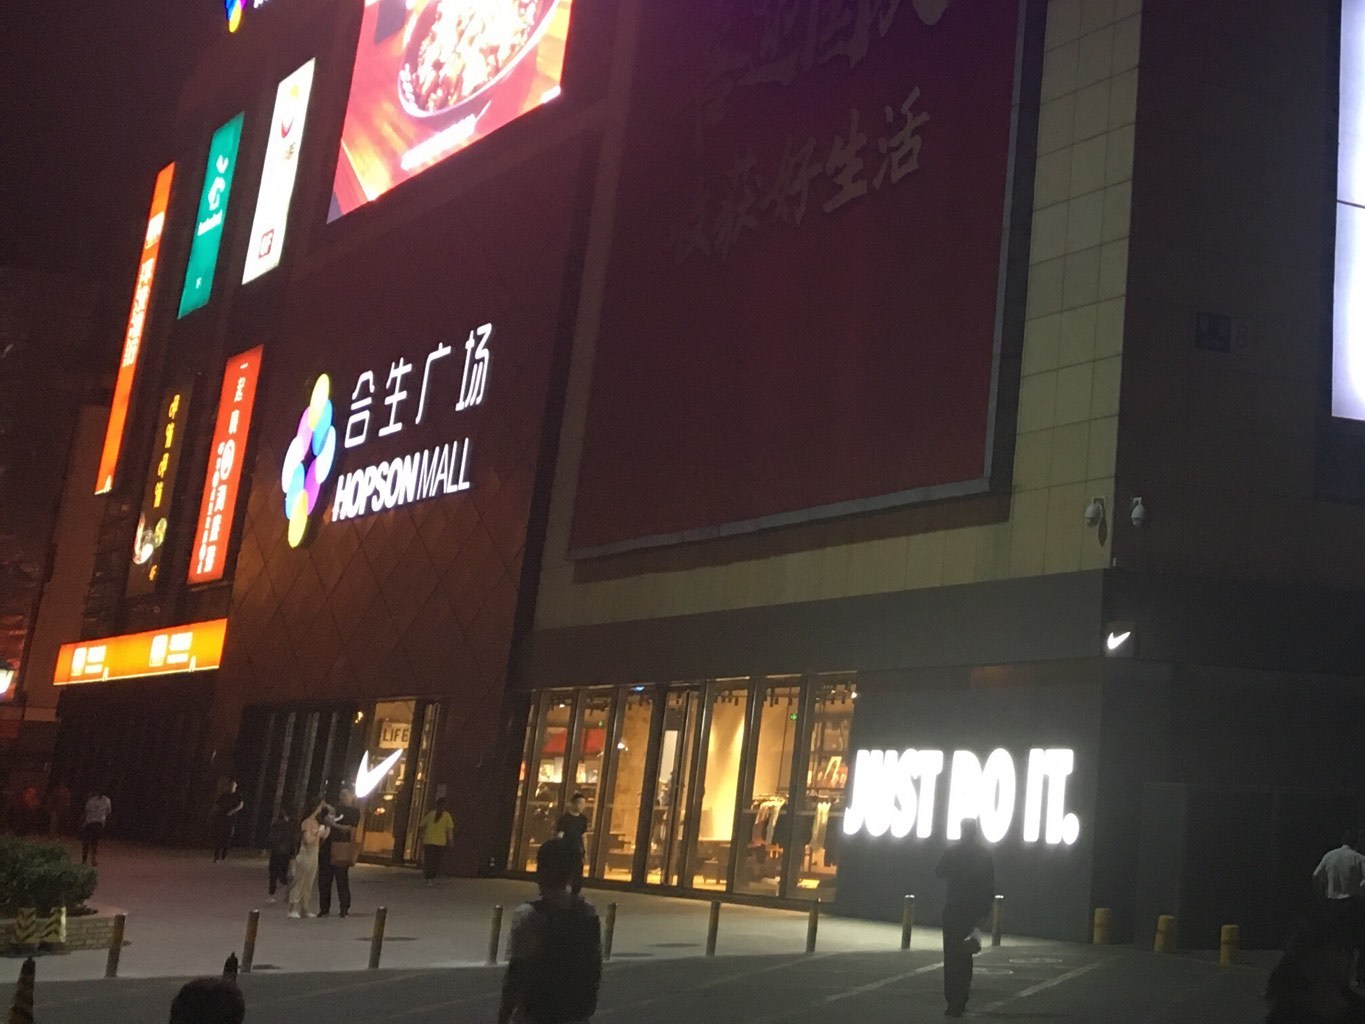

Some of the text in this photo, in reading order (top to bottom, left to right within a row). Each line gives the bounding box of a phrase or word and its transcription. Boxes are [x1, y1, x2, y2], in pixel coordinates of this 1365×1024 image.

[344, 323, 492, 449] 合生广场
[382, 728, 409, 743] LIFE
[843, 748, 944, 839] JUST
